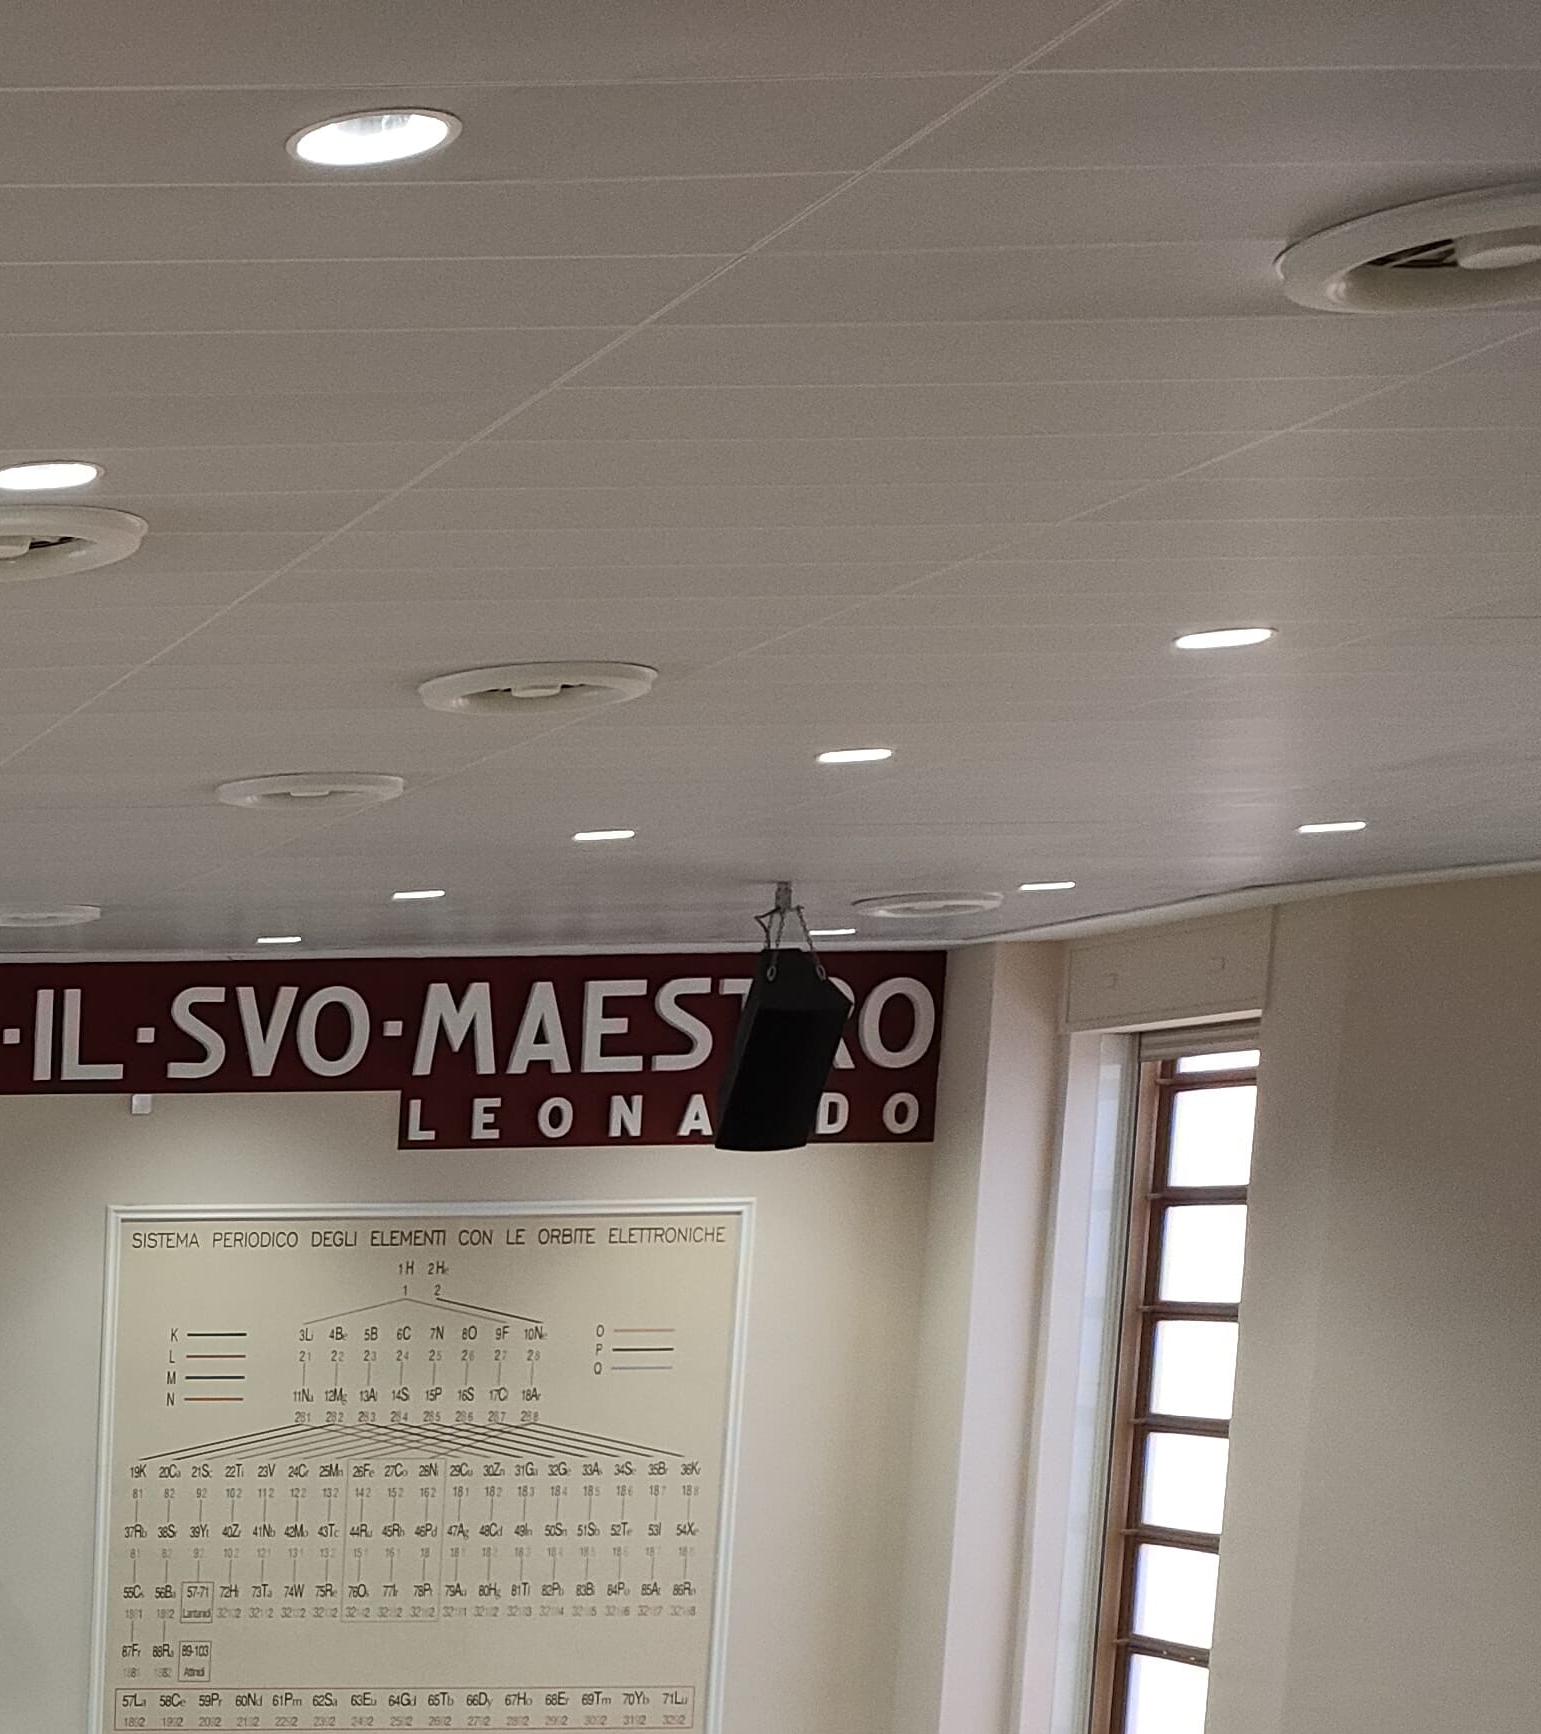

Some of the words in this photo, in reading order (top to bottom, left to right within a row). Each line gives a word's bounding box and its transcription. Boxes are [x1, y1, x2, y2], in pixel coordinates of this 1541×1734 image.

[33, 988, 123, 1081] IL
[167, 985, 371, 1078] SVO
[412, 976, 935, 1078] MAESO
[408, 1091, 919, 1142] LEONADO
[132, 1232, 200, 1248] SISTEMA
[212, 1231, 298, 1248] PERIODICO
[311, 1231, 357, 1247] DEGLI
[370, 1230, 446, 1246] ELEMENTI
[458, 1229, 493, 1246] CON
[506, 1228, 525, 1245] LE
[537, 1228, 595, 1245] ORBITE
[608, 1227, 726, 1244] ELETTRONICHE
[171, 1328, 178, 1342] K
[169, 1349, 175, 1363] L
[595, 1343, 603, 1356] P
[167, 1371, 176, 1384] M
[167, 1392, 175, 1406] N
